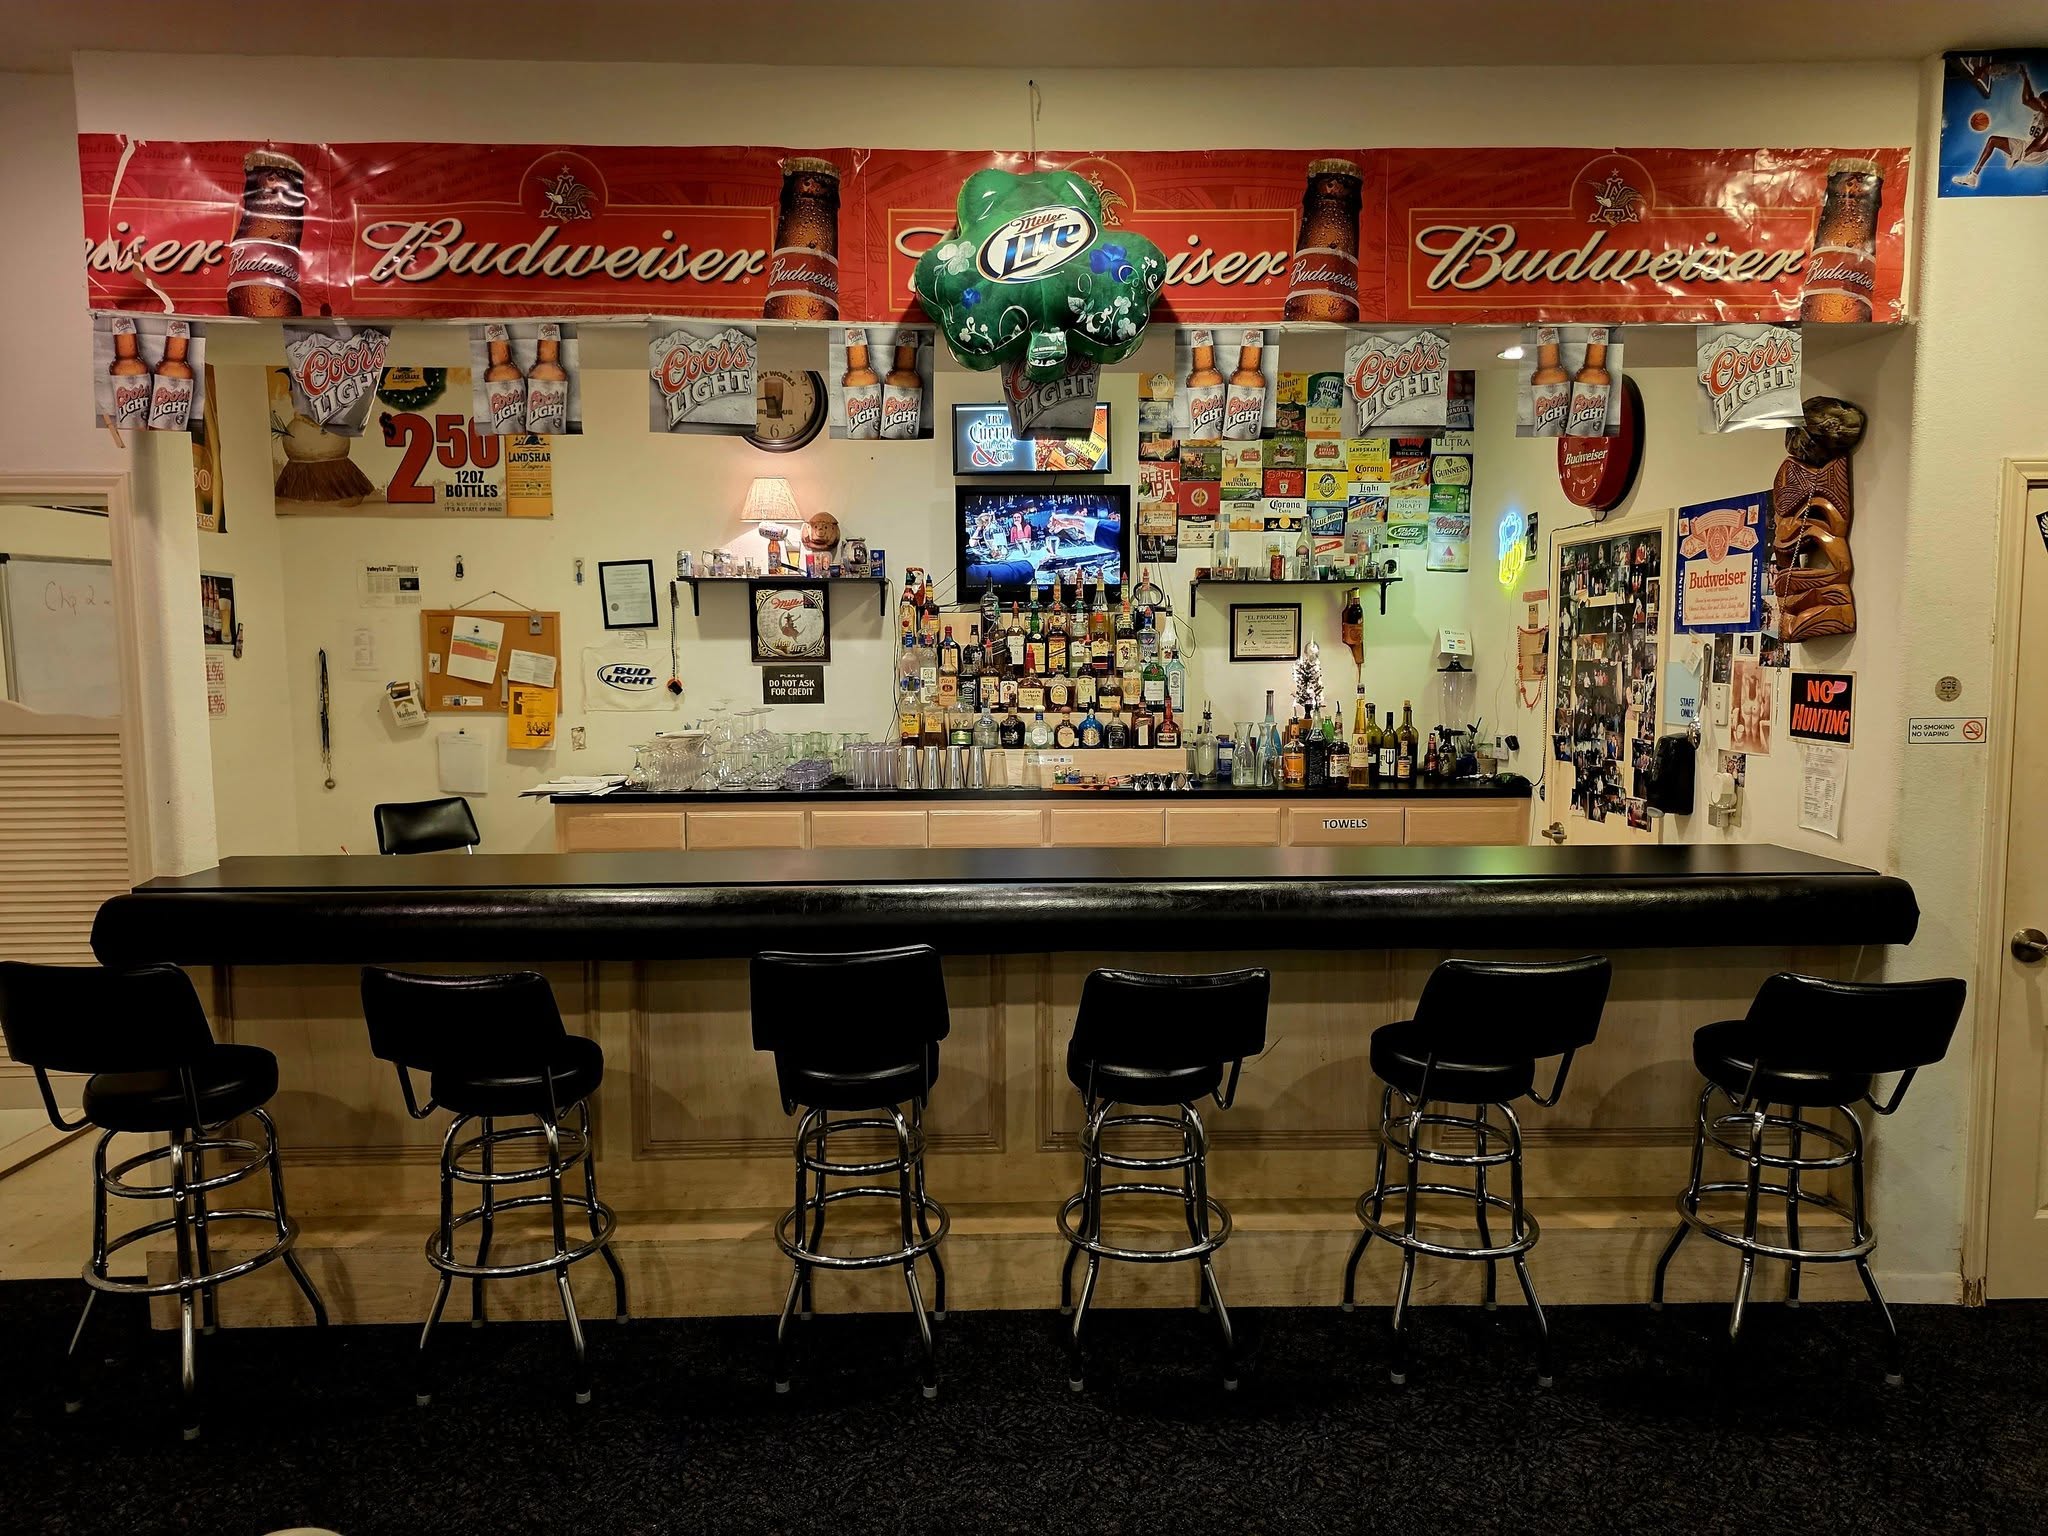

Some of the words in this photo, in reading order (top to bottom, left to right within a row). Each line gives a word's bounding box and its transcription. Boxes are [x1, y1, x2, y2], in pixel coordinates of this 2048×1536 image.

[1011, 213, 1068, 233] Miller
[362, 218, 768, 283] Budweiser
[1001, 223, 1081, 278] Lite
[1415, 224, 1806, 290] Budweiser
[295, 340, 386, 397] Coors
[652, 340, 751, 394] Coors
[1345, 343, 1441, 400] Coors
[1701, 338, 1793, 397] Coors
[769, 370, 797, 388] WORKS
[668, 370, 751, 430] LIGHT
[1322, 389, 1341, 400] ROCK
[1359, 372, 1441, 436] LIGHT
[1717, 365, 1794, 432] LIGHT
[153, 401, 189, 421] LIGHT
[529, 404, 564, 426] LIGHT
[1015, 373, 1094, 437] LIGHT
[883, 410, 918, 431] LIGHT
[986, 414, 1004, 425] TRY
[1226, 410, 1260, 431] LIGHT
[1570, 408, 1605, 429] LIGHT
[769, 425, 780, 438] 6
[969, 422, 1014, 444] Cuerv
[1435, 438, 1471, 447] ULTRA
[1564, 449, 1609, 466] Budweiser
[1141, 469, 1179, 483] REBEL
[1355, 464, 1384, 475] Corona
[1435, 465, 1468, 478] GUINNESS
[445, 484, 498, 498] BOTTLES
[1151, 478, 1176, 498] IPA
[1360, 483, 1380, 494] Light
[1269, 499, 1301, 510] Corona
[1327, 512, 1344, 523] MOON
[1435, 528, 1462, 536] LIGHT
[1689, 568, 1747, 590] Budweiser
[606, 675, 658, 686] LIGHT
[613, 666, 651, 676] BUD
[769, 679, 780, 687] DO
[781, 679, 797, 687] NOT
[798, 679, 816, 687] ASK
[771, 687, 786, 696] FOR
[787, 687, 814, 696] CREDIT
[1807, 680, 1835, 703] NO
[1680, 697, 1695, 707] STAFF
[1680, 708, 1694, 717] ONLY
[1791, 703, 1850, 736] HUNTING
[1322, 818, 1368, 829] TOWELS
